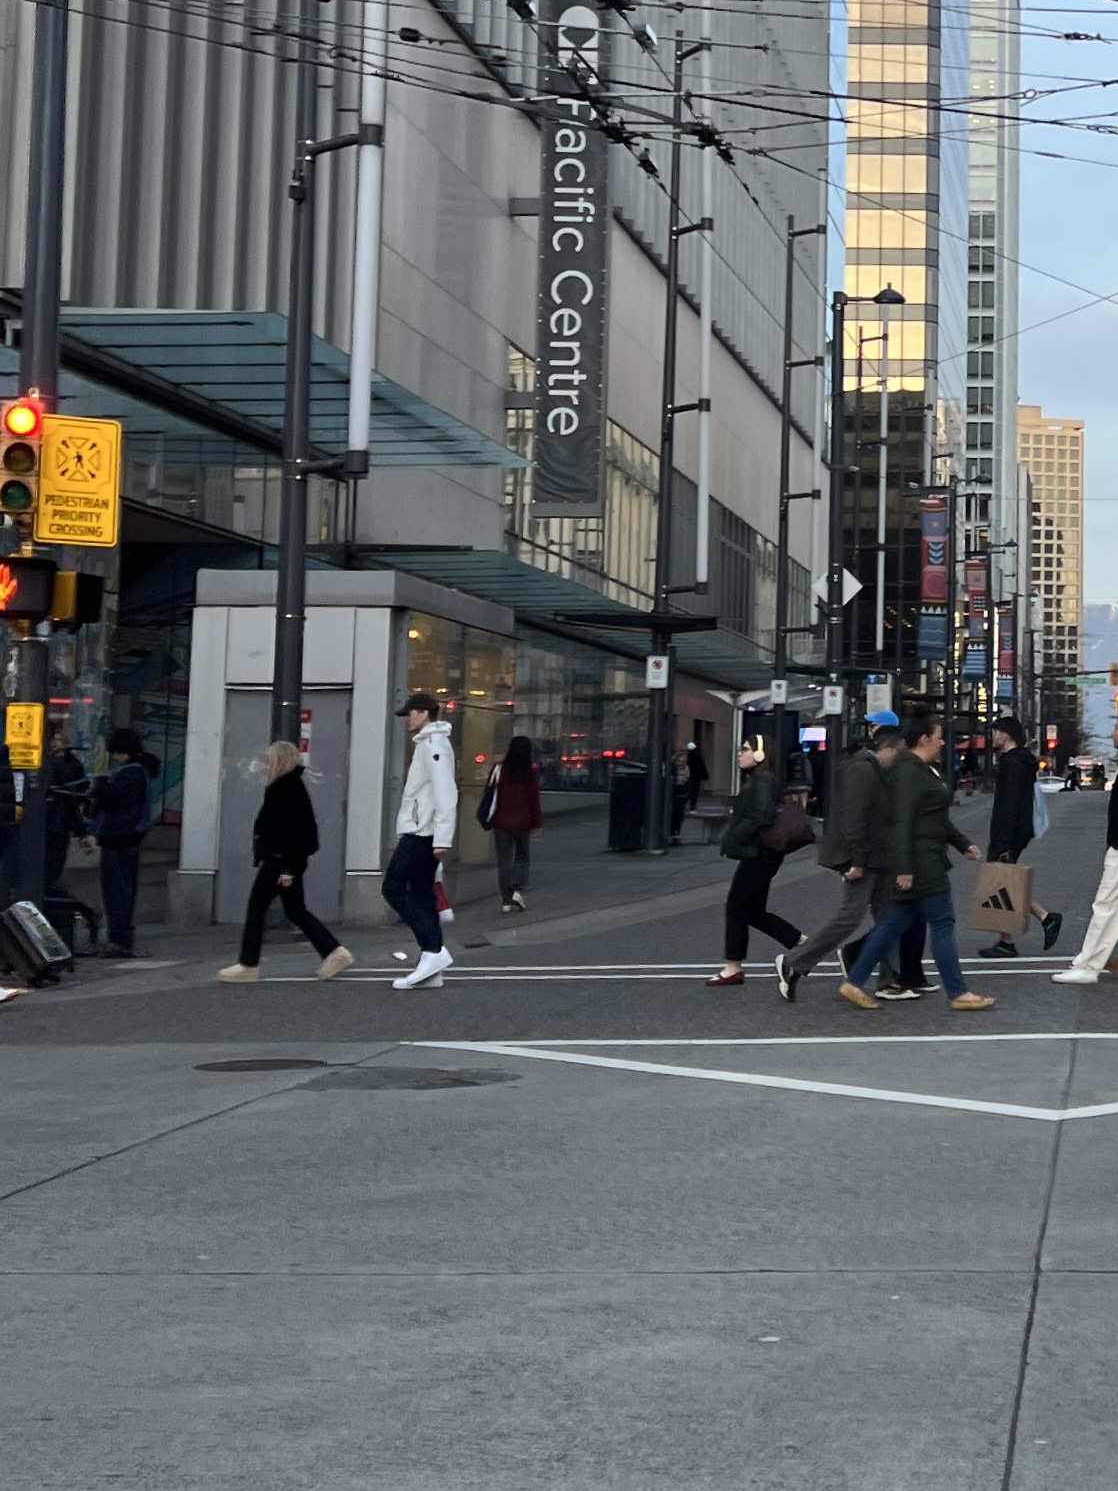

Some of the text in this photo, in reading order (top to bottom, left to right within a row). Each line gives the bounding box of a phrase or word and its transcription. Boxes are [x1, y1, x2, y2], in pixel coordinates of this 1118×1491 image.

[546, 269, 594, 437] Centre
[44, 494, 110, 510] PEDESTRIAN
[52, 509, 102, 523] PRIORITY
[48, 523, 104, 538] CROSSING
